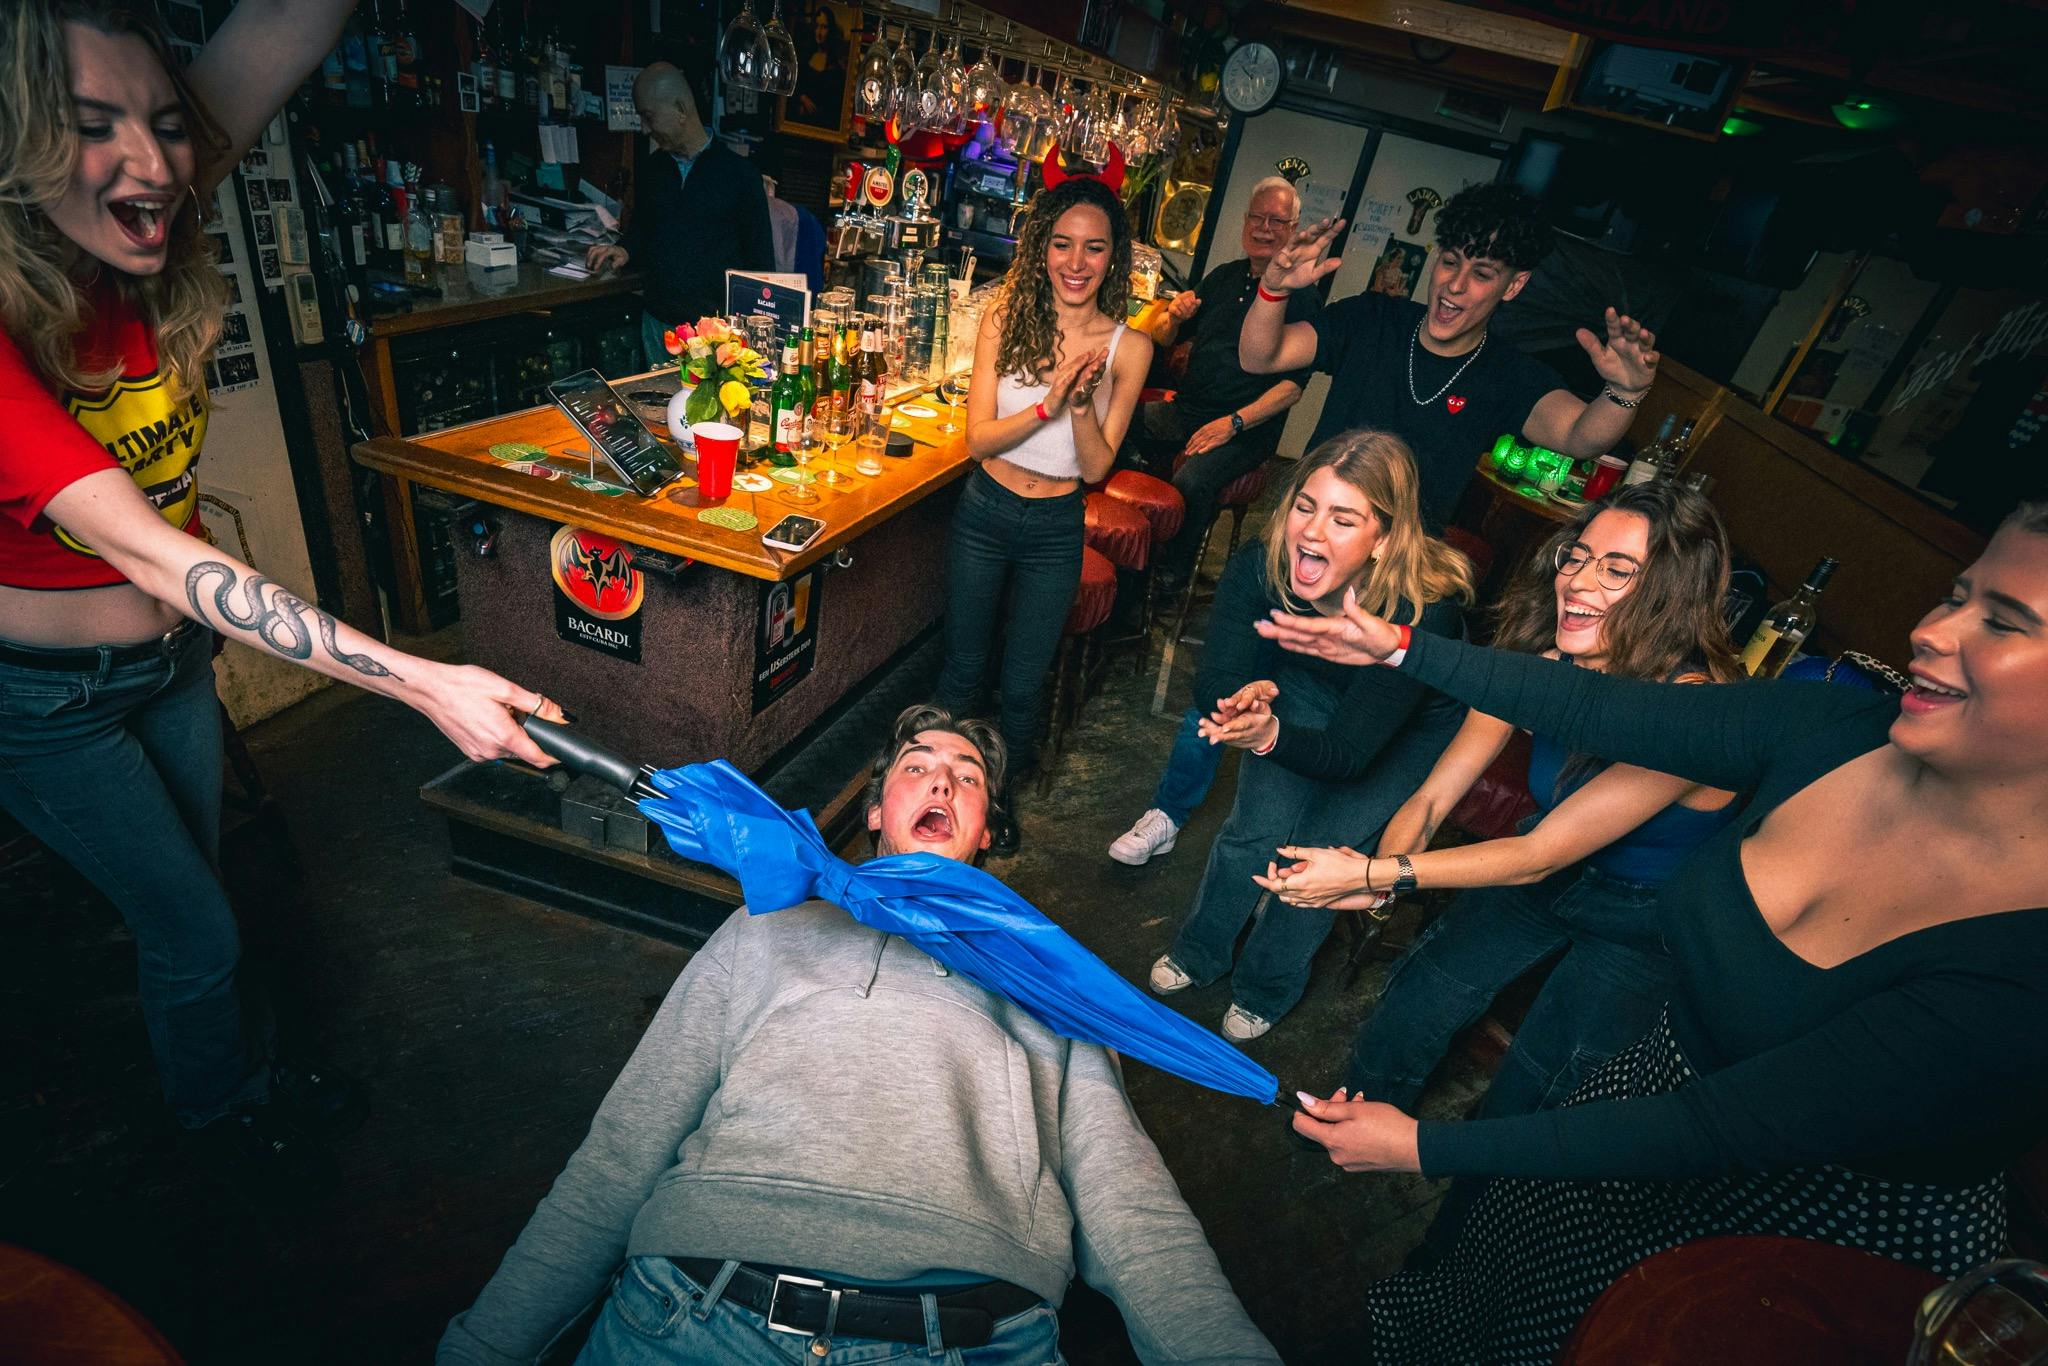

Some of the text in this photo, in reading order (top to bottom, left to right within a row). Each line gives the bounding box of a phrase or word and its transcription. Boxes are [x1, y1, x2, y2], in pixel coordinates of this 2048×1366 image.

[1278, 158, 1310, 177] GENTS
[1408, 188, 1441, 208] LADIES
[106, 393, 202, 461] LTIMATE
[568, 616, 630, 647] BACARDI
